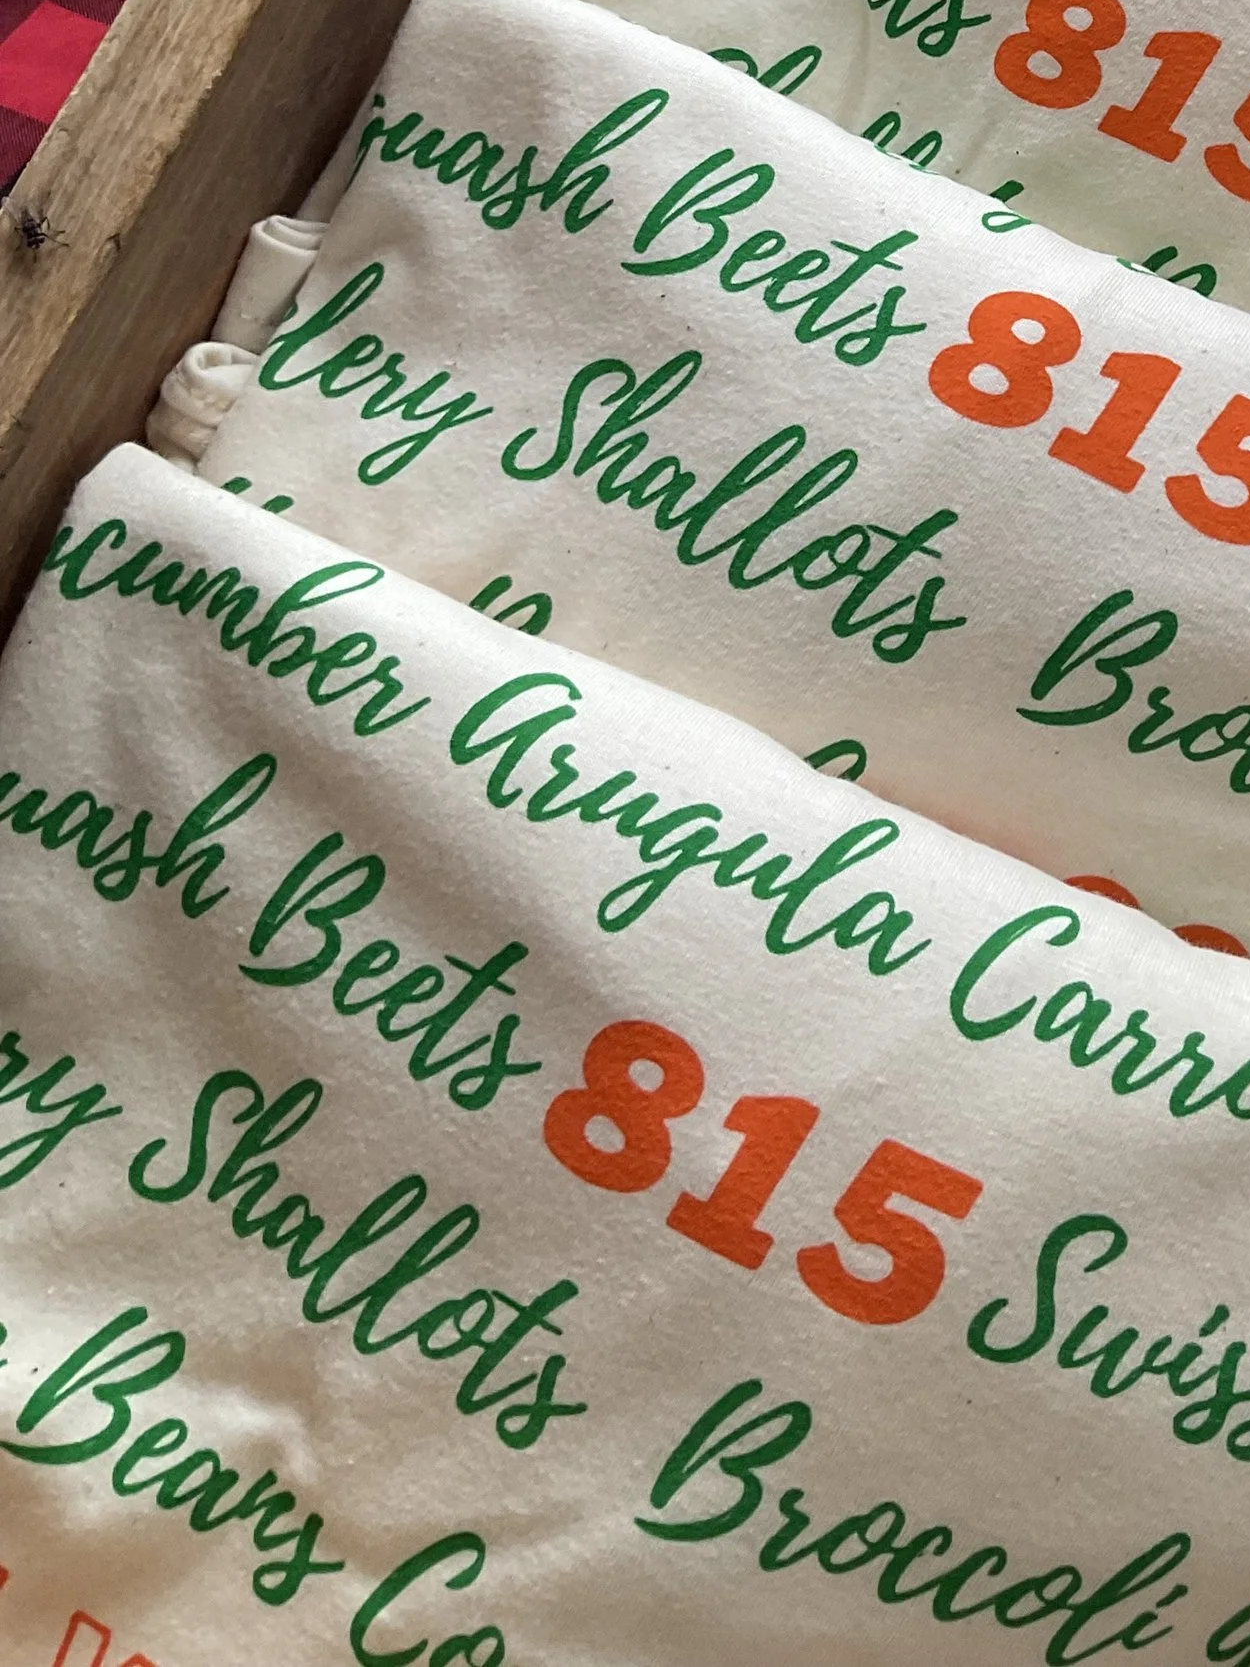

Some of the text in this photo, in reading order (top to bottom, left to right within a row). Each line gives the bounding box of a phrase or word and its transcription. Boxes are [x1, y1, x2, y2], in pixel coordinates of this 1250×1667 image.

[620, 148, 928, 366] Beets
[258, 261, 494, 485] lery
[501, 350, 968, 663] Shallots
[449, 672, 931, 975] Arugula
[238, 832, 542, 1111] Beets
[543, 1020, 983, 1325] 815
[0, 1305, 345, 1606] Beans
[128, 1069, 588, 1450] Shallots
[634, 1378, 1192, 1667] Broccoli
